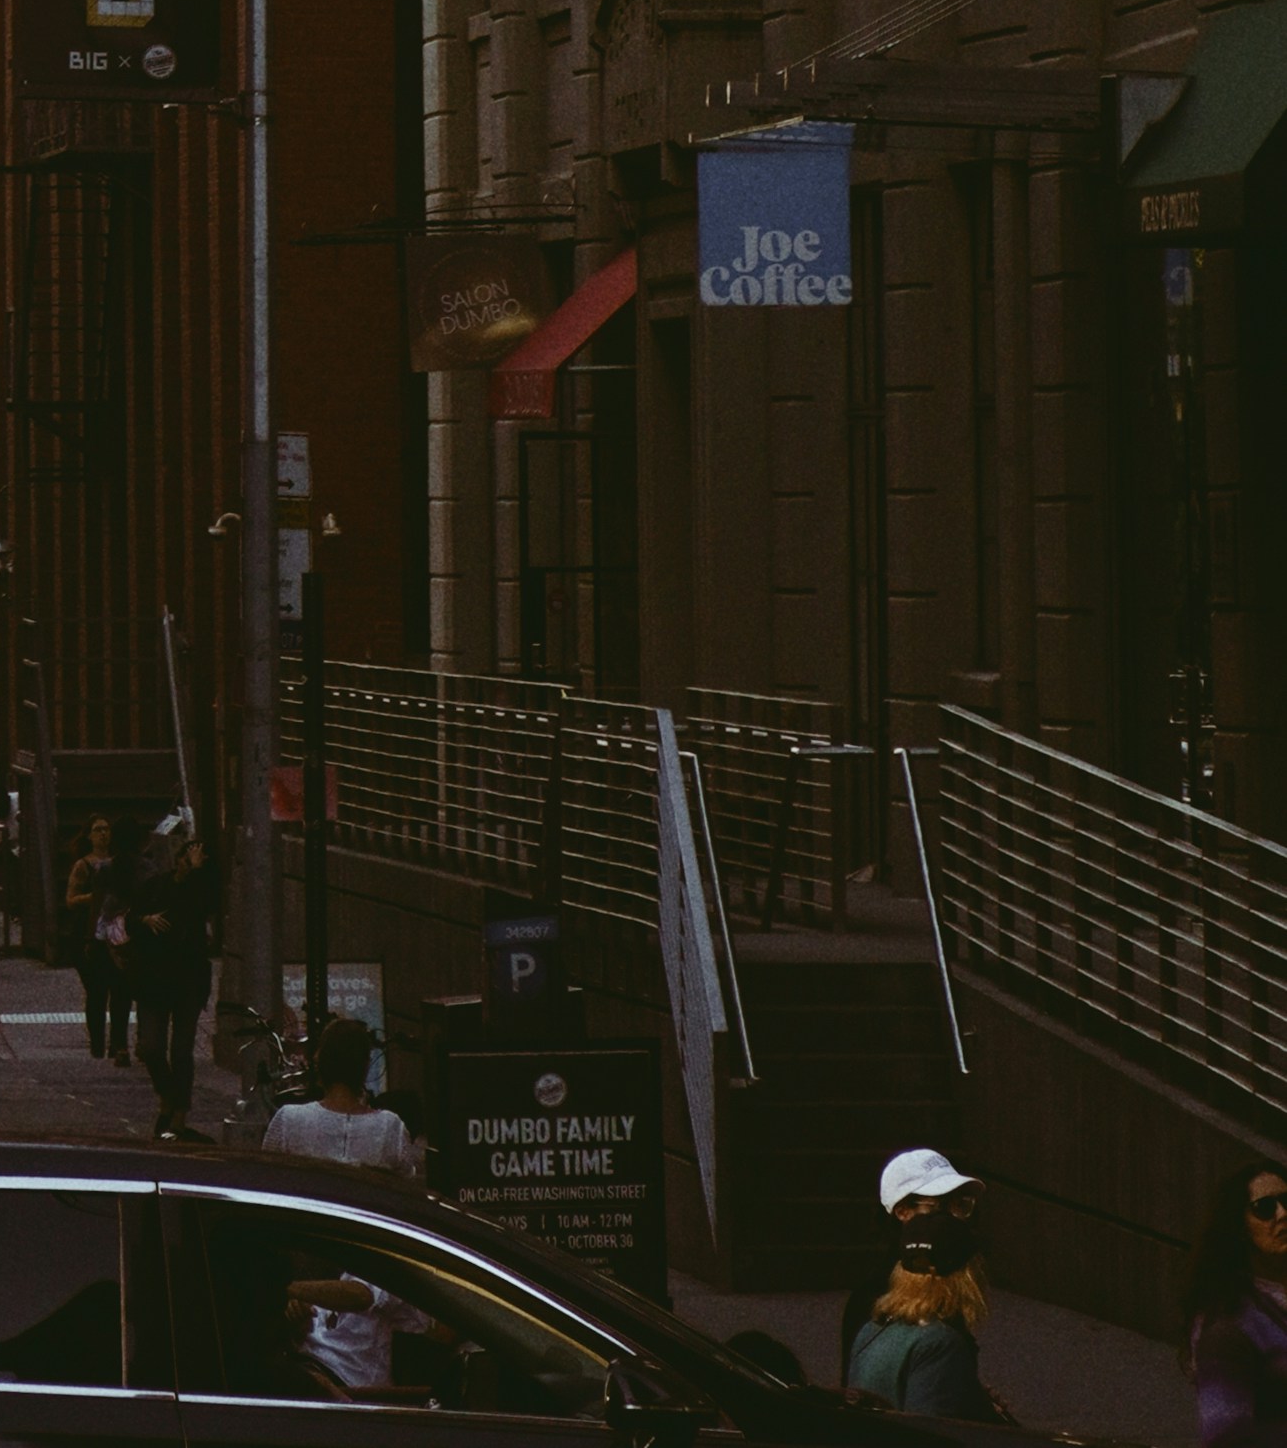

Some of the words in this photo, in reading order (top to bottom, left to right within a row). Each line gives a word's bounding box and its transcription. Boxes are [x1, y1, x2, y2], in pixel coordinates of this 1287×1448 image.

[68, 51, 108, 71] BIG
[730, 223, 824, 274] Joe
[439, 278, 510, 315] SALON
[699, 261, 854, 307] Coffee
[439, 297, 522, 336] DUMBO
[327, 974, 375, 991] aves,
[510, 952, 536, 993] P
[468, 1117, 551, 1145] DUMBO
[556, 1115, 636, 1144] FAMILY
[489, 1150, 556, 1178] GAME
[559, 1148, 615, 1176] TIME
[458, 1187, 476, 1204] ON
[478, 1186, 530, 1202] CAR-FREE
[530, 1185, 605, 1201] WASHINGTON
[606, 1184, 647, 1200] STREET
[557, 1215, 570, 1229] 10
[572, 1214, 590, 1228] AM
[599, 1214, 612, 1228] 12
[614, 1213, 633, 1228] PM
[568, 1234, 619, 1249] OCTOBER
[620, 1234, 634, 1248] 30
